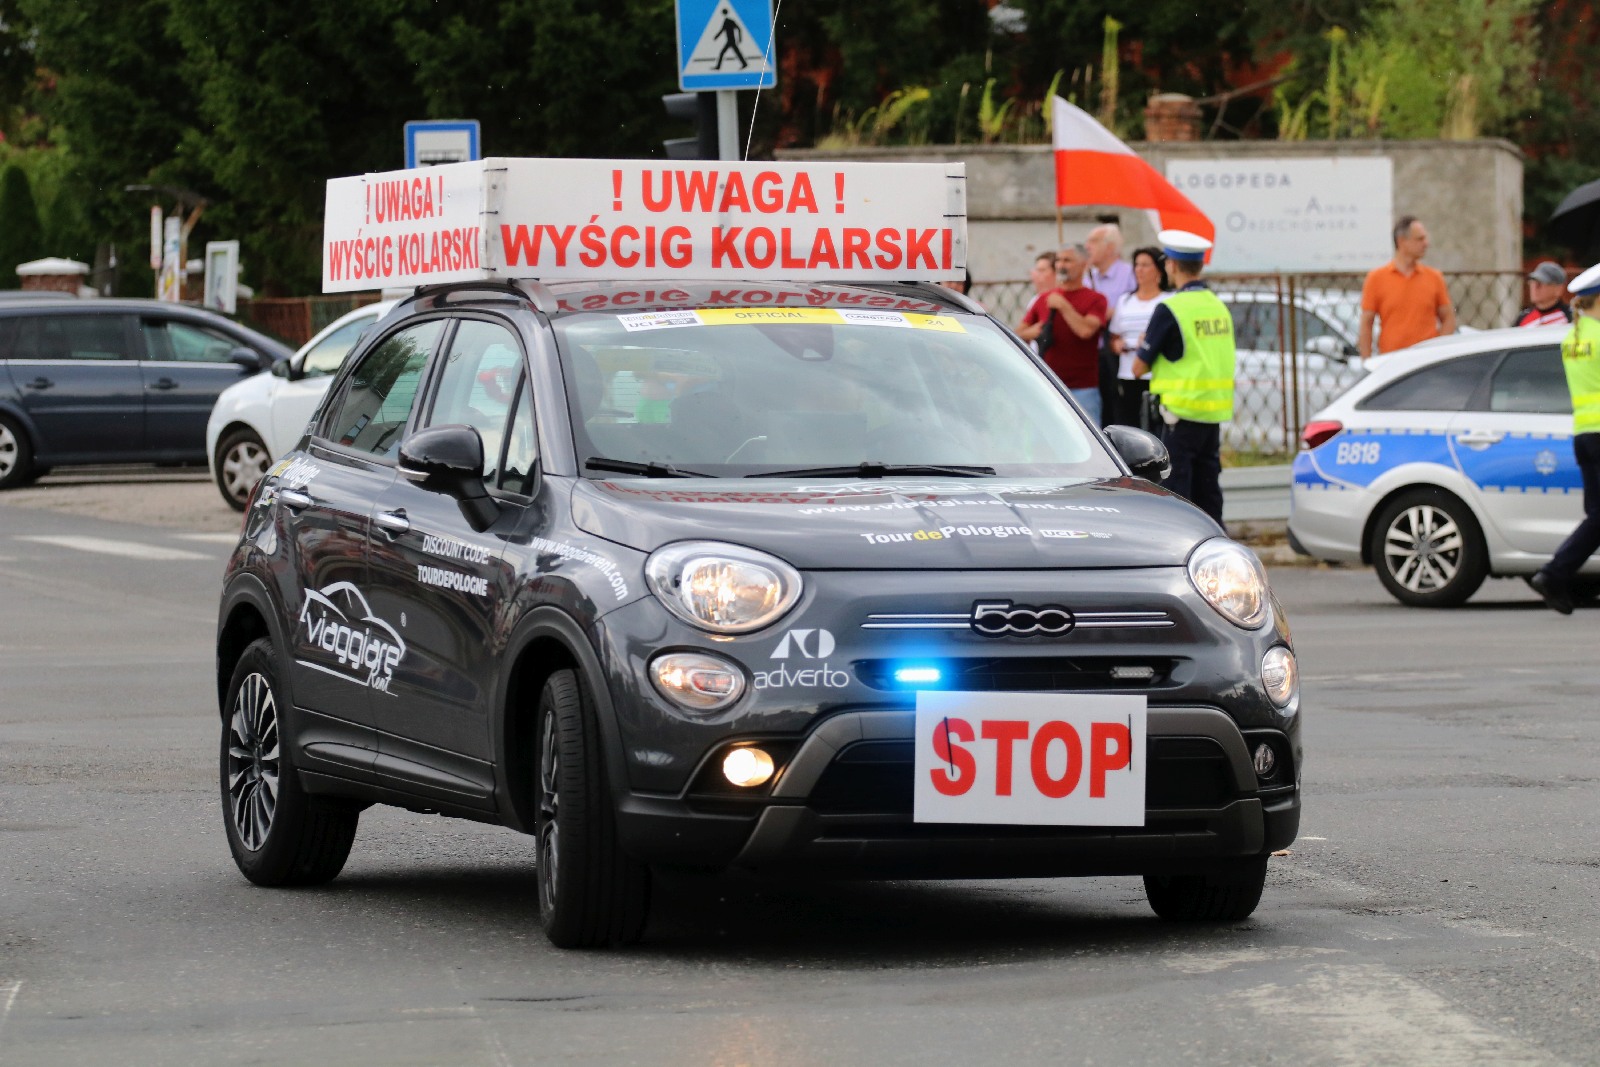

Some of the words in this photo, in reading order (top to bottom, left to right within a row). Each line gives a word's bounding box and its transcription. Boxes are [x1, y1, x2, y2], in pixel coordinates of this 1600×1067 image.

[611, 169, 624, 212] !
[641, 170, 819, 213] UWAGA
[834, 172, 846, 213] !
[1175, 172, 1291, 190] LOGOPEDA
[366, 184, 371, 225] !
[375, 176, 434, 224] UWAGA
[438, 175, 443, 217] !
[328, 228, 393, 282] WYŚCIG
[398, 226, 480, 276] KOLARSKI
[500, 214, 693, 269] WYŚCIG
[711, 226, 953, 270] KOLARSKI
[734, 311, 806, 320] OFFICIAL
[1336, 442, 1381, 465] B818
[422, 535, 464, 559] DISCOUNT
[417, 564, 489, 597] TOURDEPOLOGNE
[974, 602, 1072, 633] 500
[753, 664, 850, 691] adverto
[929, 717, 1132, 799] STOP
